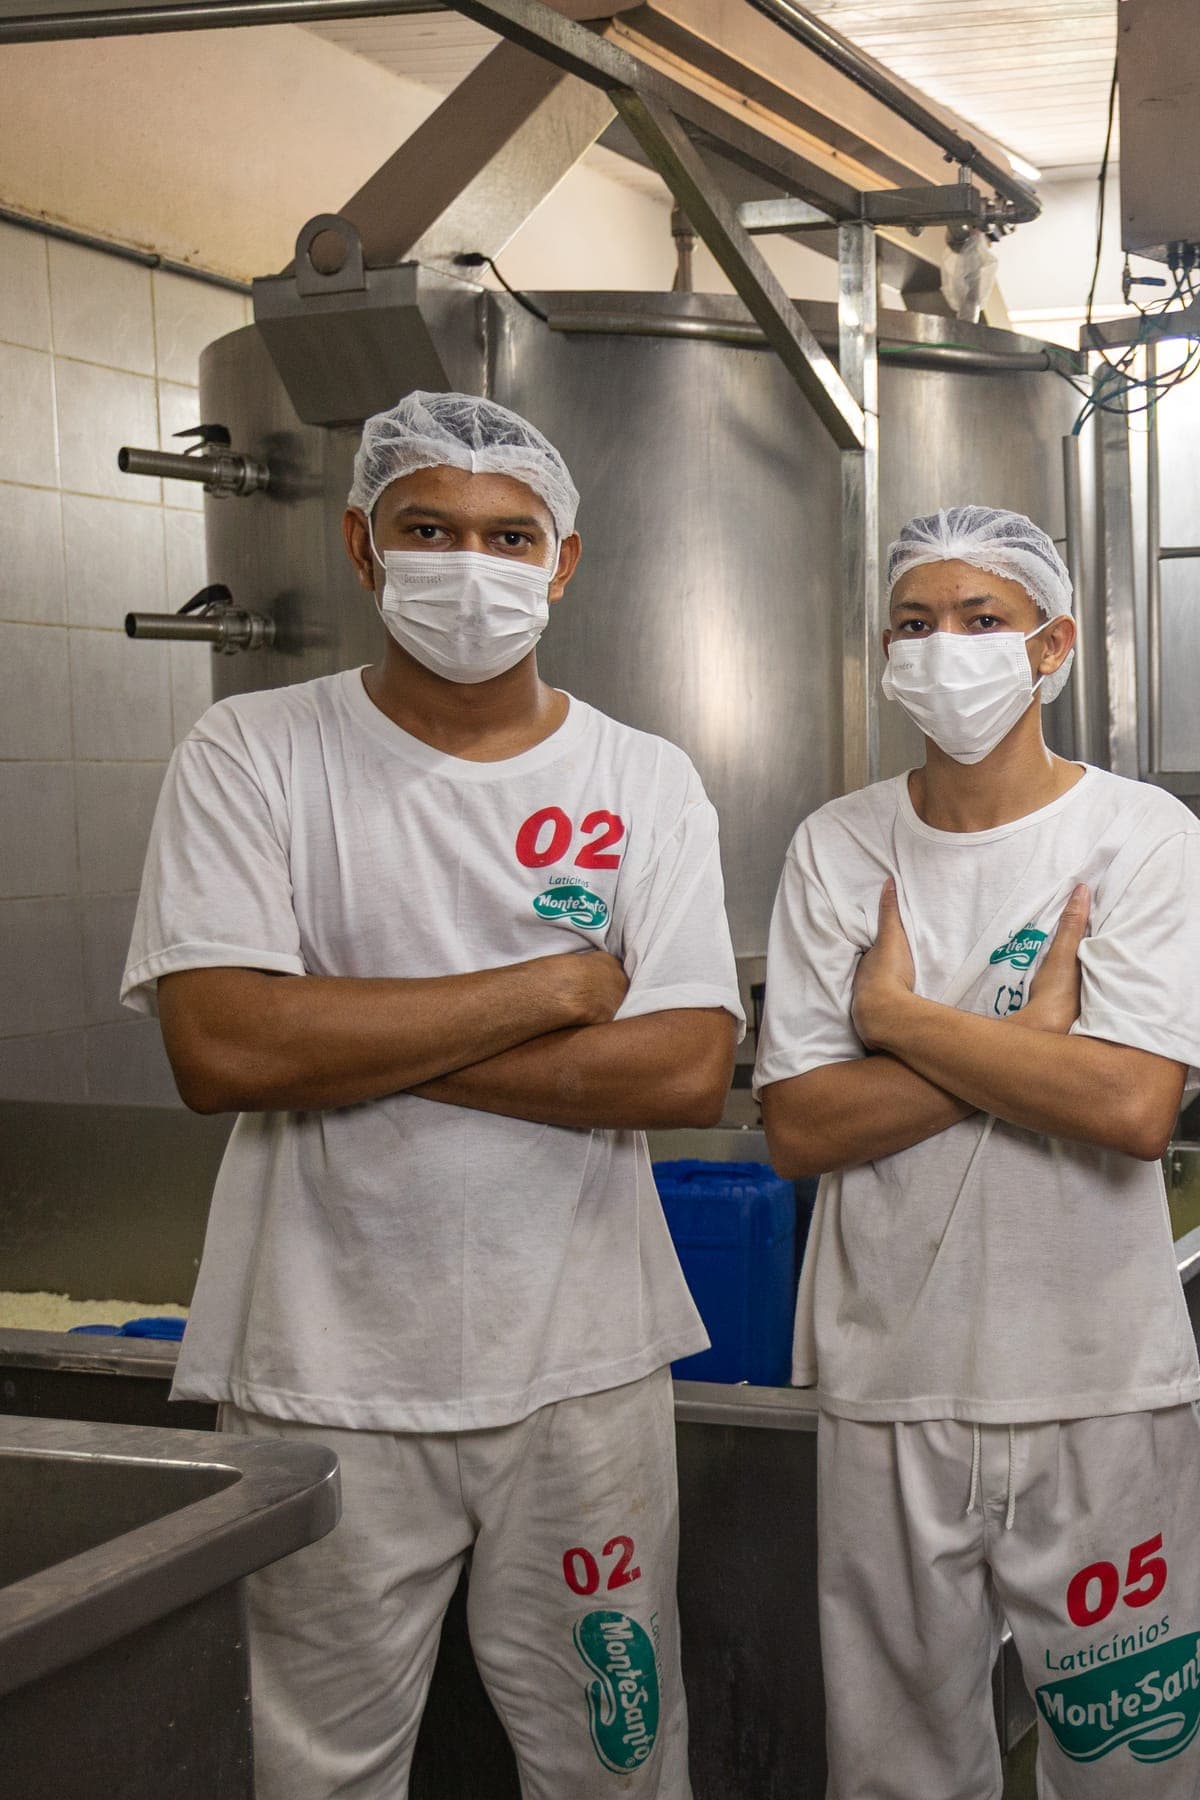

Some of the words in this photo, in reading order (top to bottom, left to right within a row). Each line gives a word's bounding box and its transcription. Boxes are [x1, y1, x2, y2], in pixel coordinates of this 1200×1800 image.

[515, 805, 625, 870] 02
[561, 1535, 642, 1596] 02
[1066, 1531, 1168, 1628] 05
[1045, 1615, 1170, 1671] Laticínios
[599, 1616, 652, 1761] MonteSanto
